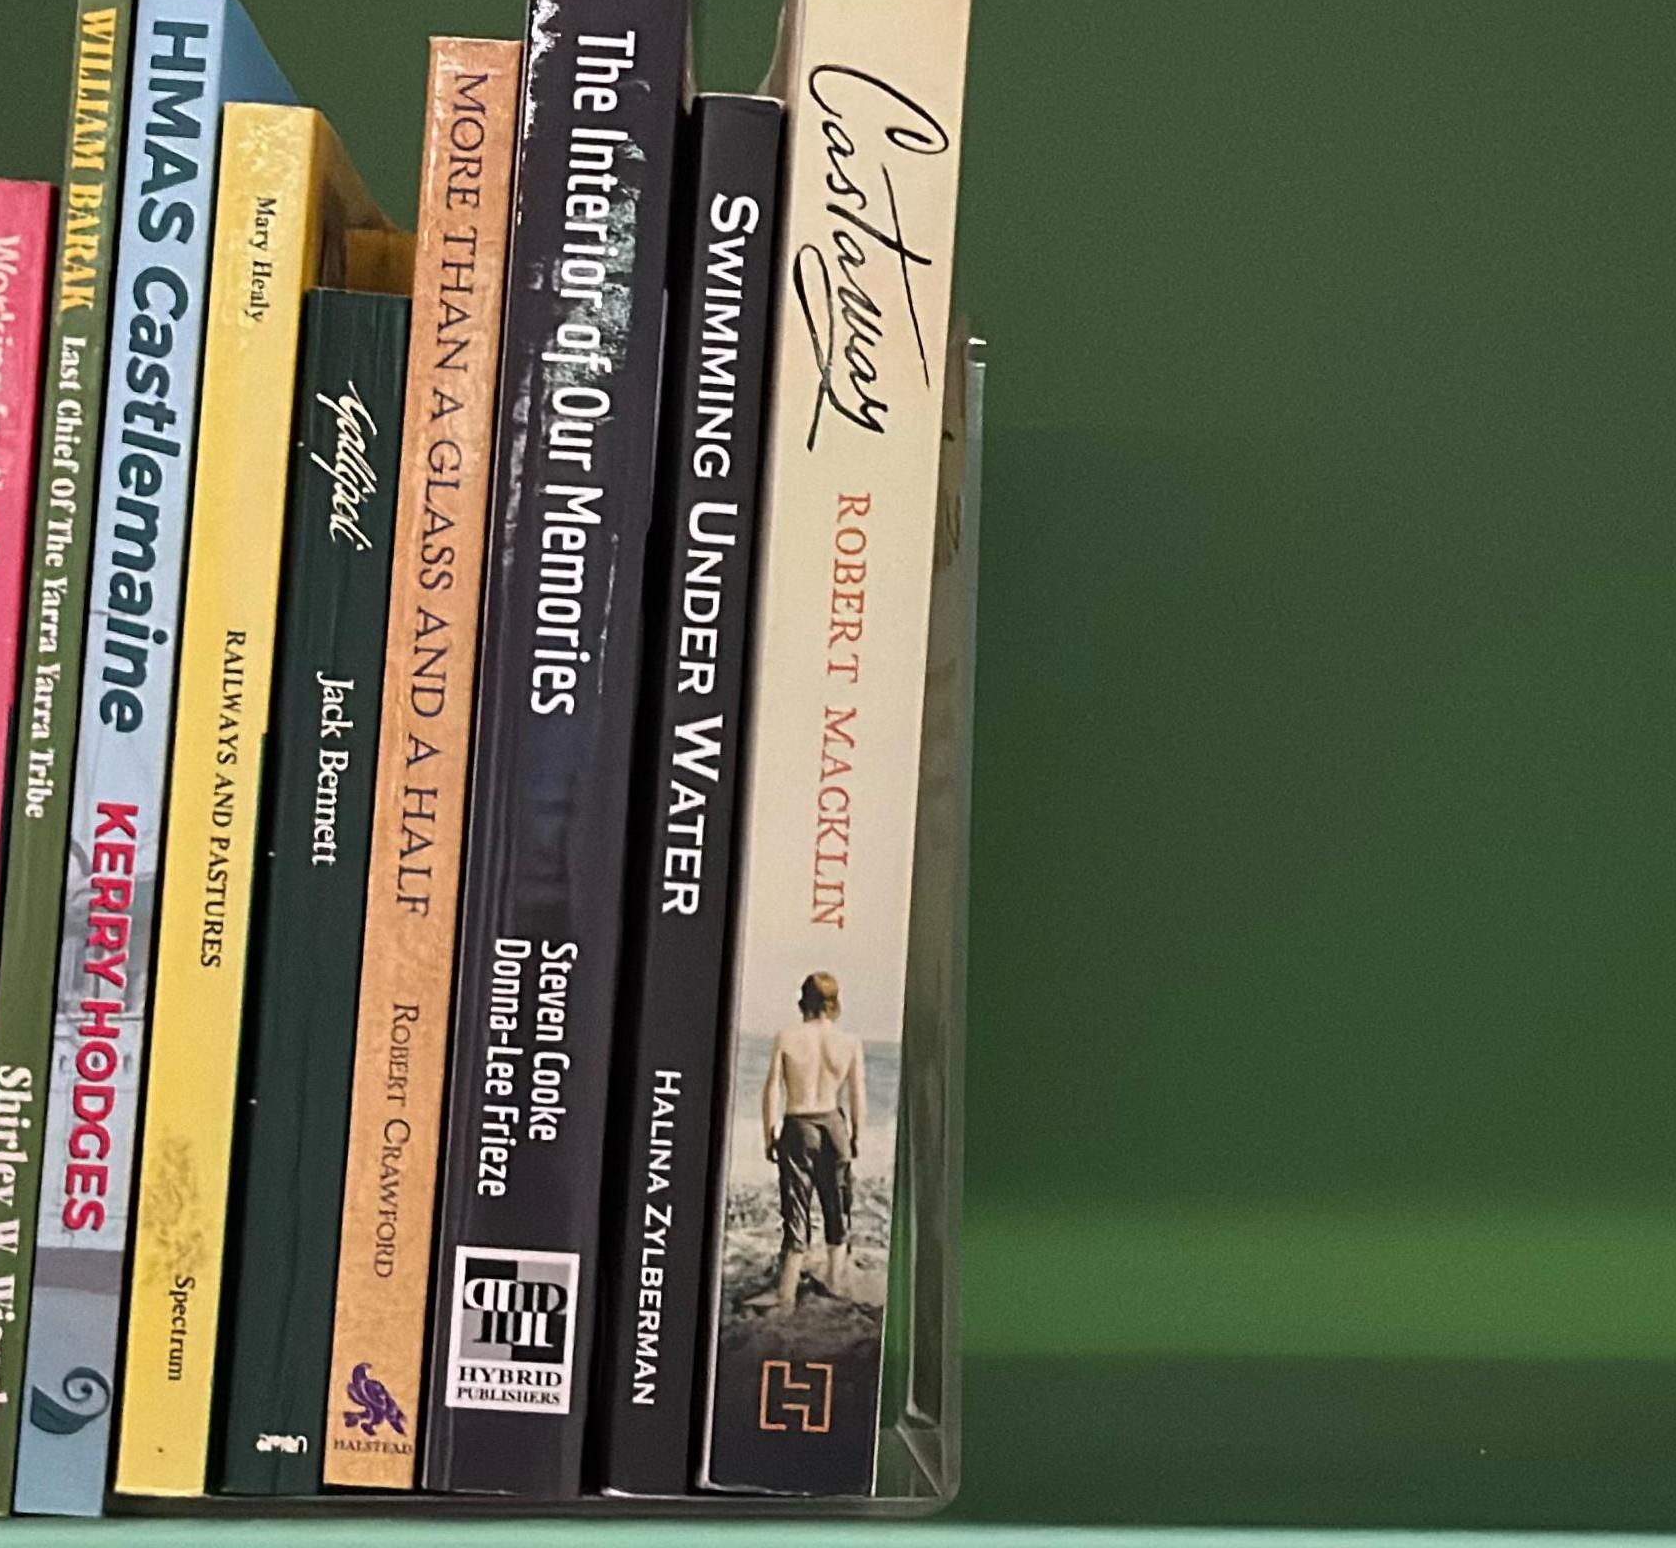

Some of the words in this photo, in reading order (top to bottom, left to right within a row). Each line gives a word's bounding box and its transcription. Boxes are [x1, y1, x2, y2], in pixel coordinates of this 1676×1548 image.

[70, 7, 117, 172] WILLIAM
[571, 29, 636, 113] The
[137, 20, 209, 245] HMAS
[444, 71, 489, 210] MORE
[60, 182, 104, 312] BARAK
[248, 196, 277, 252] Mary
[561, 127, 628, 312] Interior
[792, 64, 949, 453] Castaway
[244, 260, 274, 324] Healy
[438, 226, 478, 372] THAN
[542, 322, 613, 374] of
[691, 194, 761, 479] SWIMMING
[59, 335, 87, 392] Last
[432, 387, 465, 420] A
[53, 398, 82, 474] Chief
[310, 380, 378, 552] Gallipoli
[548, 386, 611, 473] Our
[43, 516, 73, 568] The
[99, 265, 189, 734] Castlemaine
[417, 440, 463, 593] GLASS
[37, 576, 68, 654] Yarra
[531, 482, 604, 717] Memories
[676, 503, 739, 695] UNDER
[828, 492, 872, 683] ROBERT
[30, 662, 60, 740] Yarra
[216, 629, 247, 766] RAILWAYS
[316, 671, 355, 739] Jack
[409, 606, 451, 719] AND
[25, 747, 55, 820] Tribe
[210, 773, 236, 829] AND
[312, 748, 350, 866] Bennett
[407, 733, 441, 768] A
[395, 784, 439, 919] HALF
[660, 713, 724, 917] WATER
[810, 706, 859, 930] MACKLIN
[82, 802, 139, 989] KERRY
[200, 835, 231, 969] PASTURES
[485, 937, 532, 1097] Donna-Lee
[536, 939, 578, 1042] Steven
[61, 1001, 123, 1233] HODGES
[388, 1002, 420, 1110] ROBERT
[528, 1050, 572, 1144] Cooke
[476, 1104, 520, 1200] Frieze
[645, 1068, 682, 1194] HALINA
[372, 1117, 412, 1279] CRAWFORD
[167, 1274, 196, 1382] Spectrum
[631, 1203, 673, 1406] ZYLBERMAN
[456, 1386, 561, 1405] PUBLISHERS
[459, 1366, 563, 1387] HYBRID
[333, 1438, 413, 1455] HALSTEAD
